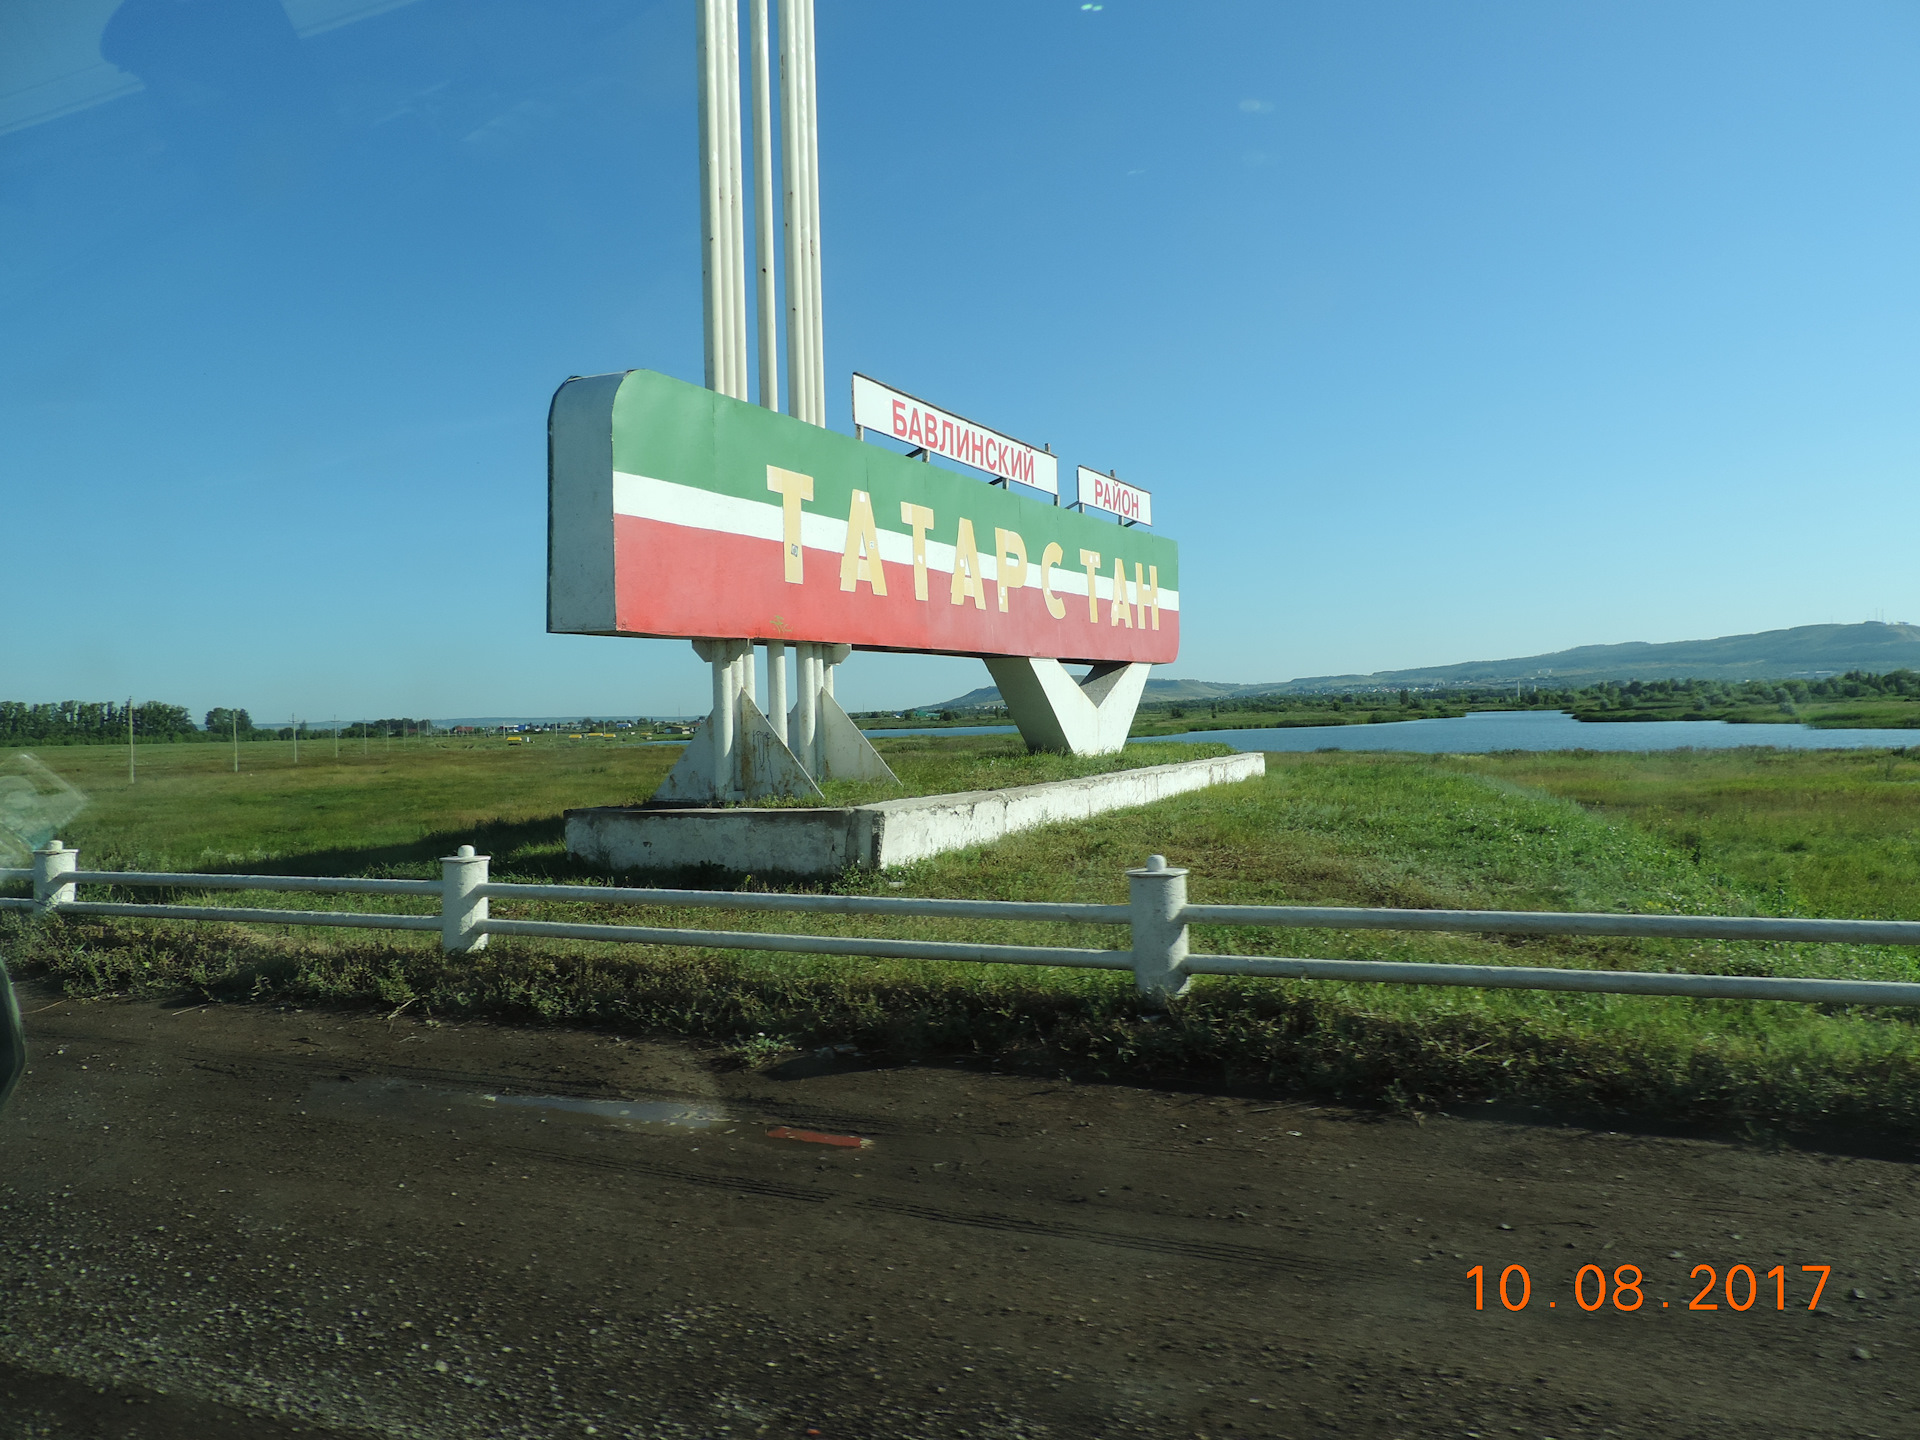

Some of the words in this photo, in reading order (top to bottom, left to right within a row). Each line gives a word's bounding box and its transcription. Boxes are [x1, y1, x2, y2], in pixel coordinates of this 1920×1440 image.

[892, 399, 1035, 484] БАВЛИНСКИЙ
[1094, 478, 1139, 519] РАЙОН
[766, 464, 1160, 631] ТАТАРСТАН
